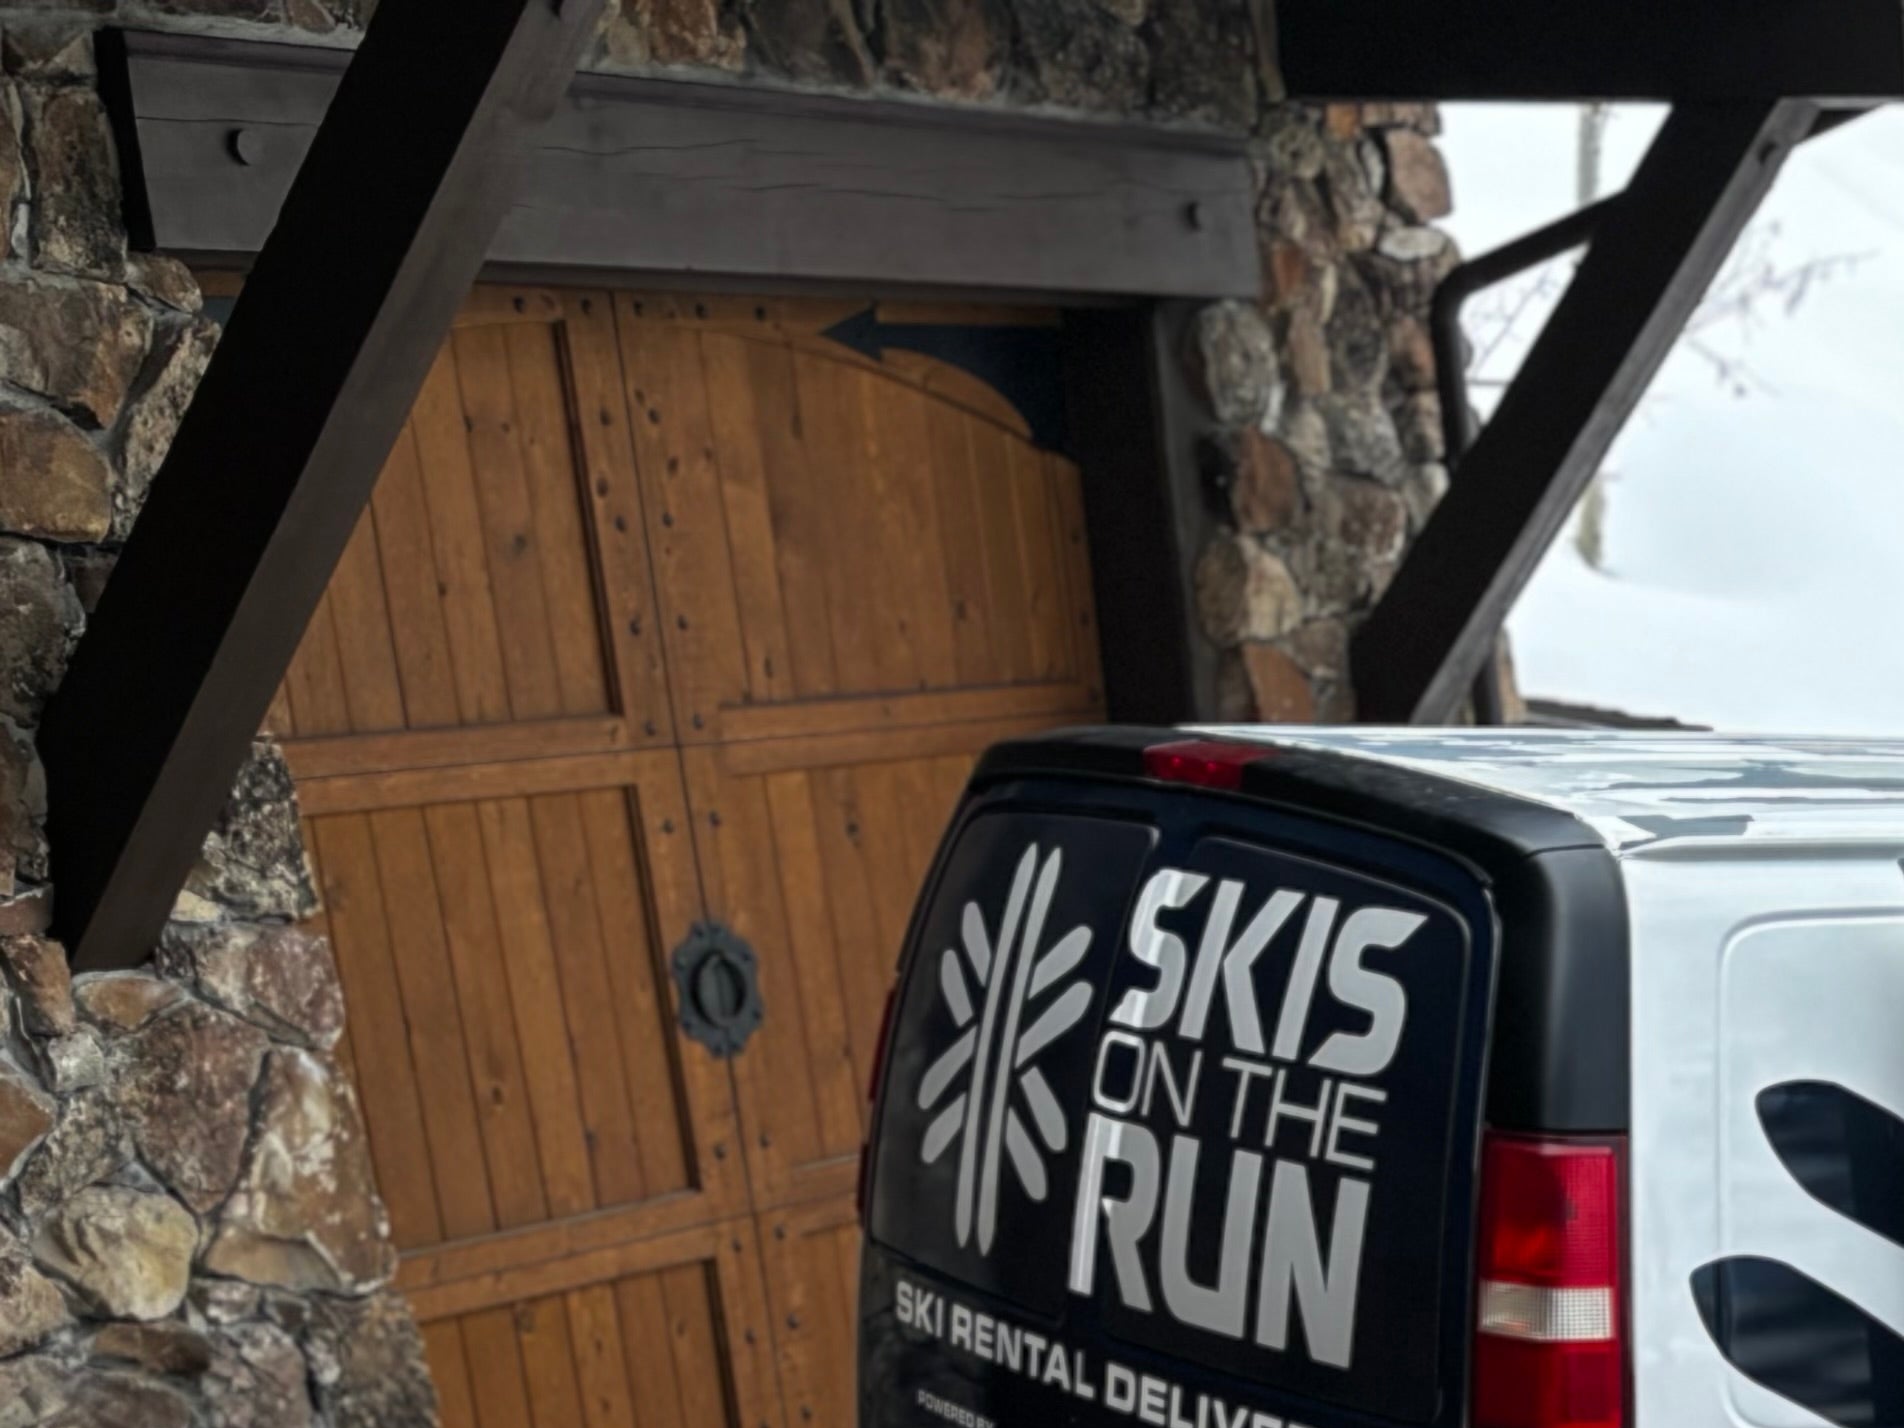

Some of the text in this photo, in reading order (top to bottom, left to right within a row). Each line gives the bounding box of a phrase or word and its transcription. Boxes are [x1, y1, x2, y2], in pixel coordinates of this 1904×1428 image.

[1108, 867, 1428, 1076] SKIS
[1093, 1030, 1388, 1171] ON THE
[1068, 1111, 1371, 1369] RUN
[895, 1280, 945, 1339] SKI
[950, 1306, 1096, 1400] RENTAL
